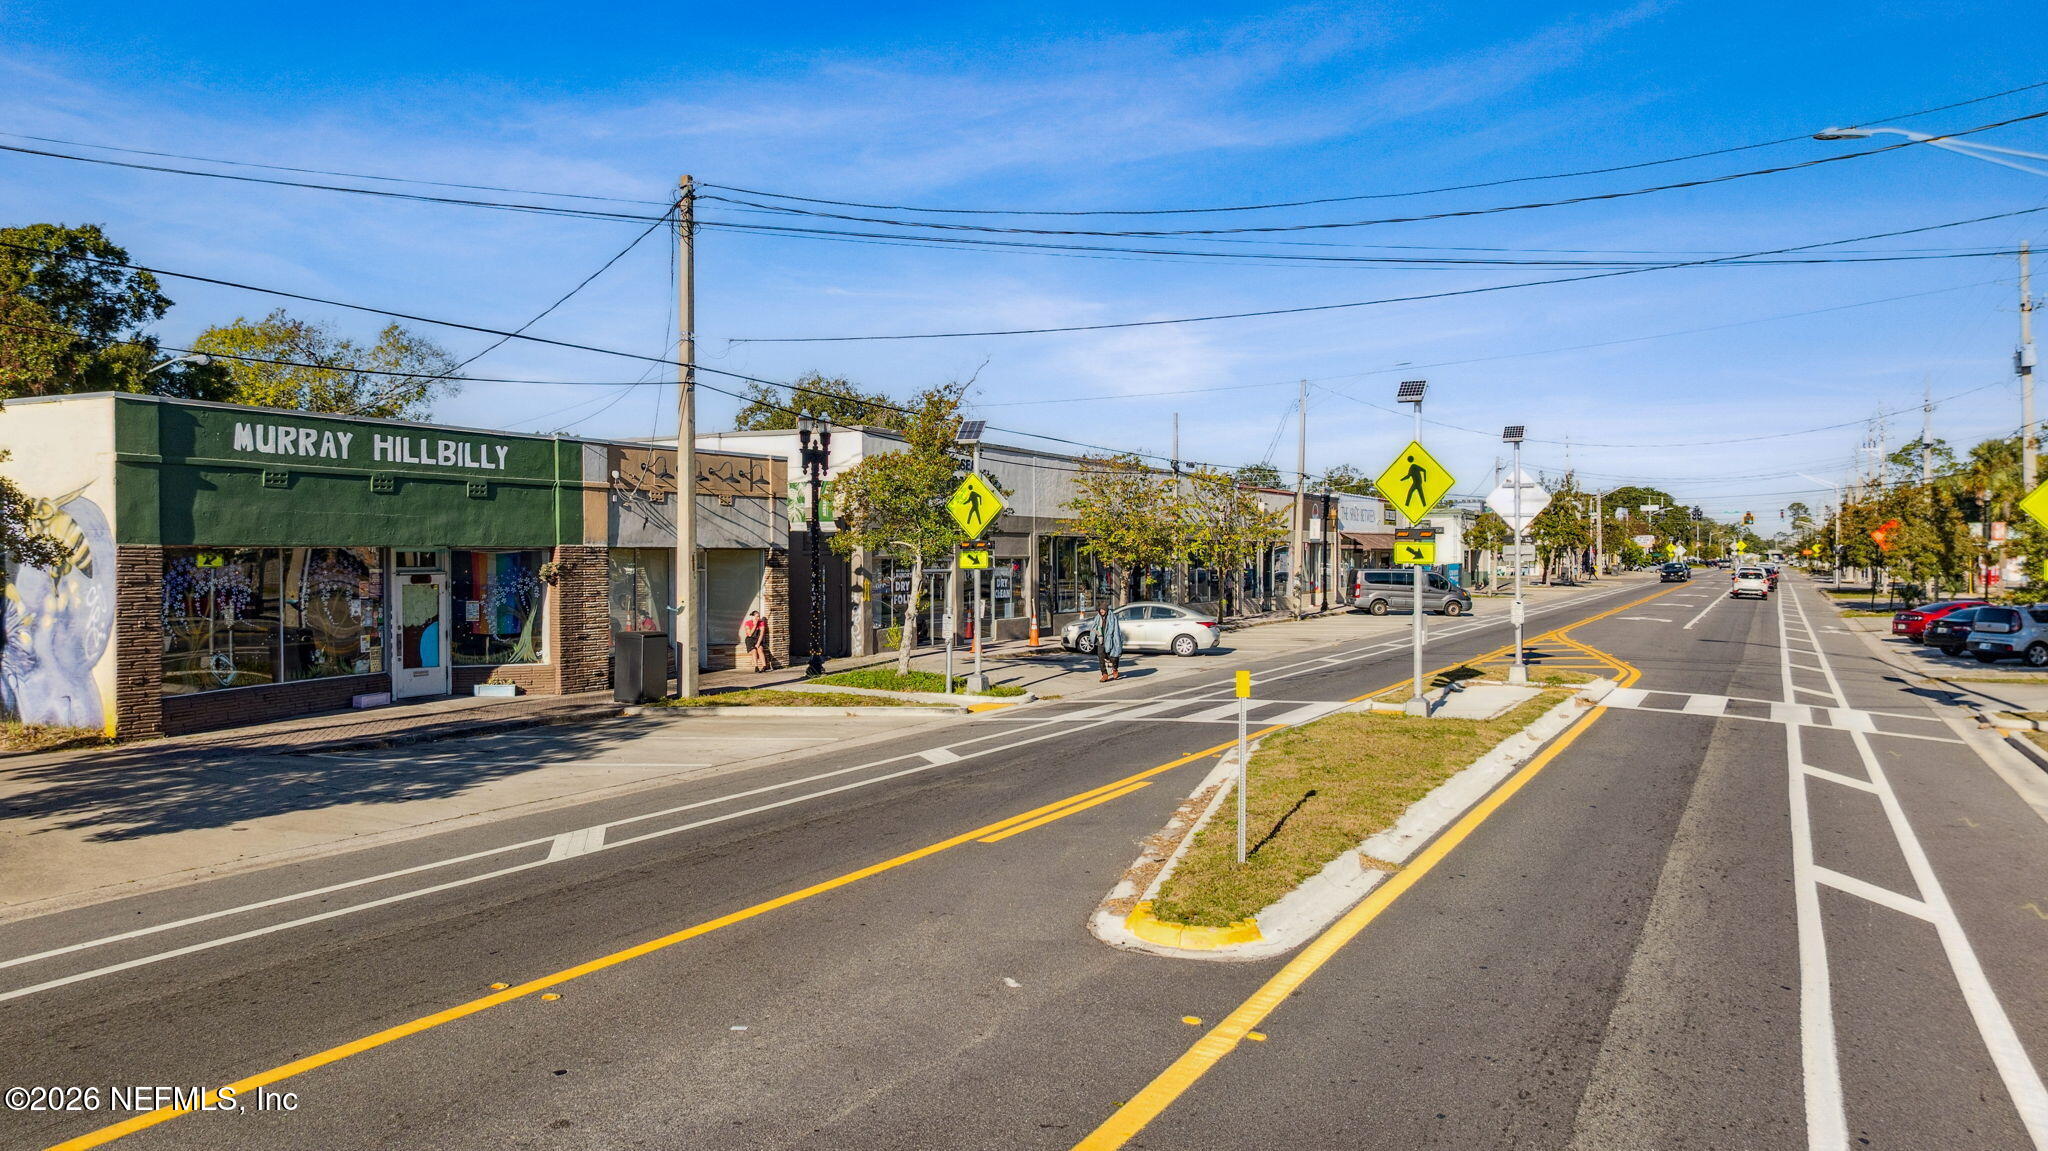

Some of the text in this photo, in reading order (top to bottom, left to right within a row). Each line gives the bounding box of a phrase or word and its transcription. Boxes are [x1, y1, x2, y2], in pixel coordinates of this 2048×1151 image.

[233, 422, 509, 470] MURRAY HILLBILLY
[895, 581, 910, 592] DRY
[996, 578, 1008, 588] DRY
[995, 589, 1011, 599] CLEAN
